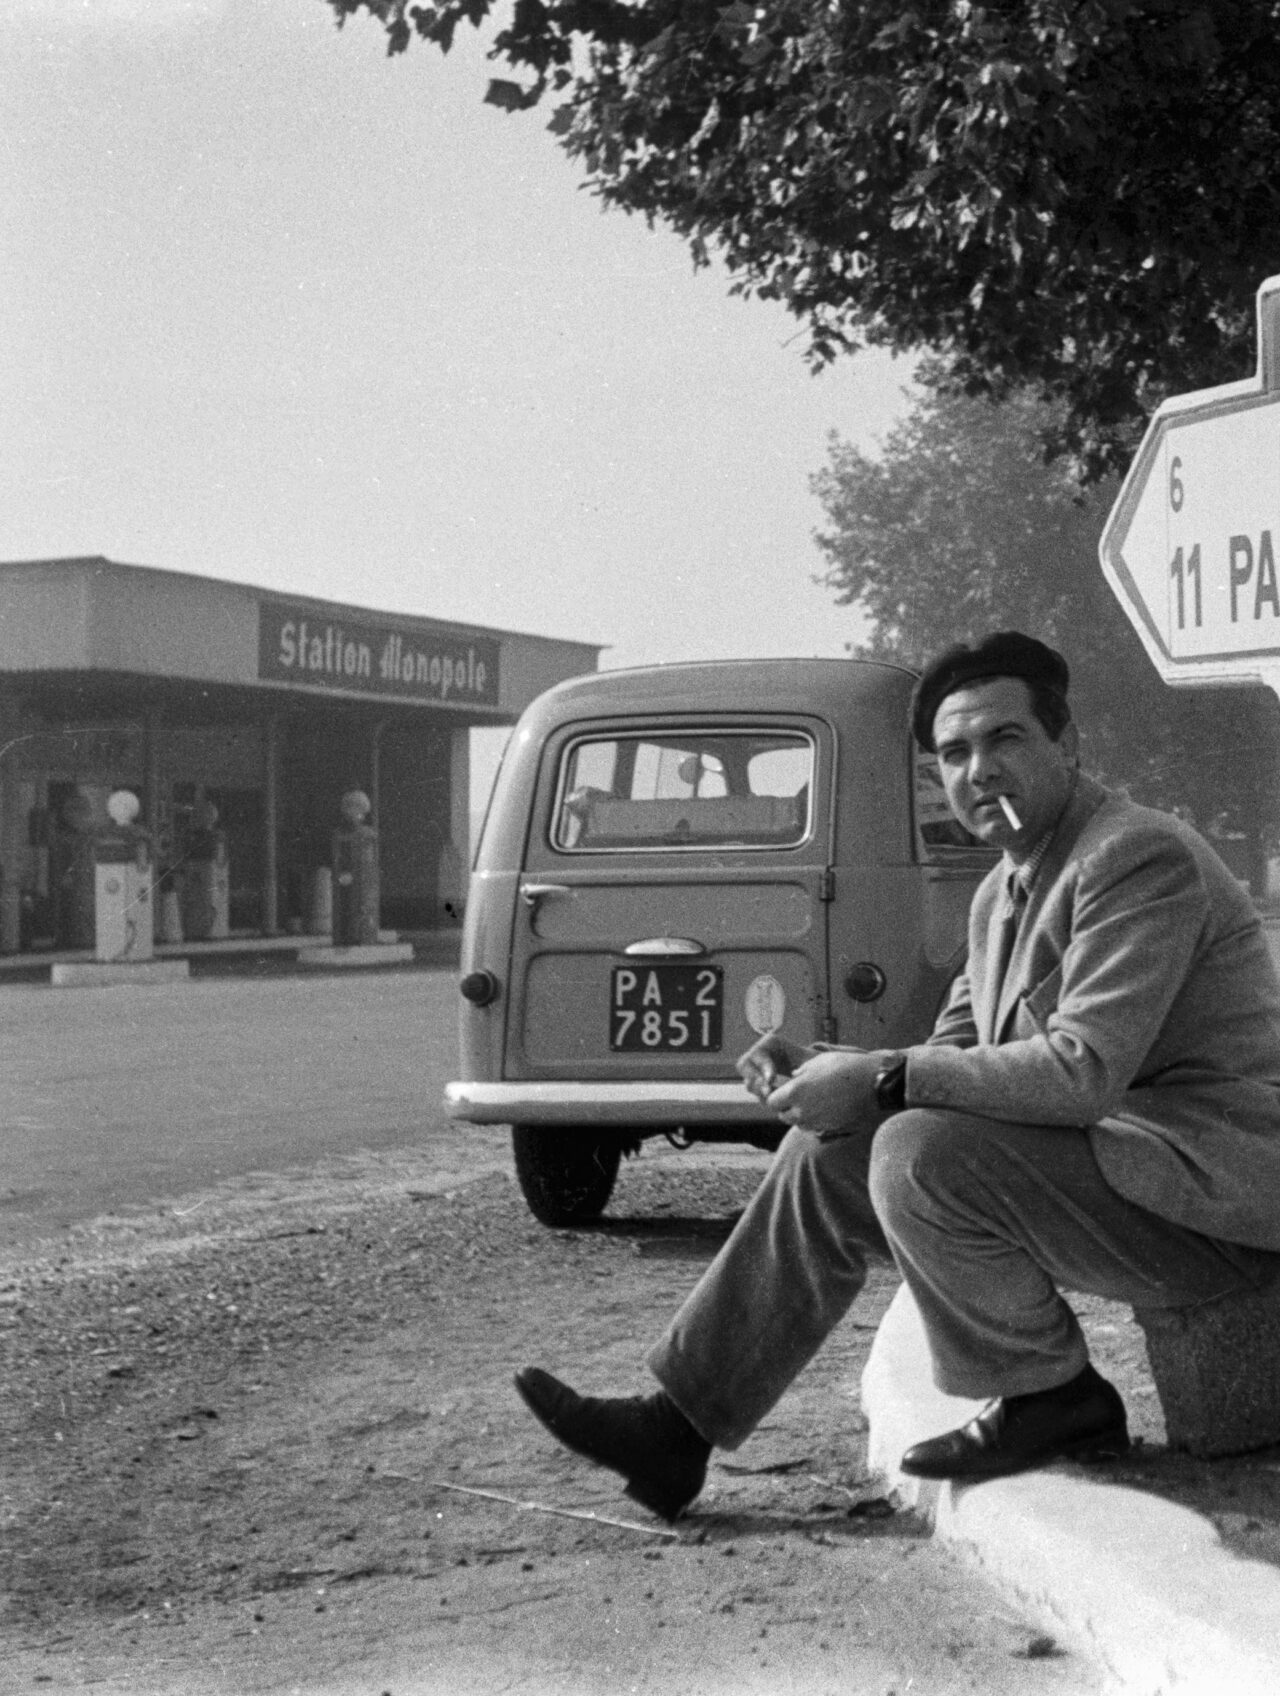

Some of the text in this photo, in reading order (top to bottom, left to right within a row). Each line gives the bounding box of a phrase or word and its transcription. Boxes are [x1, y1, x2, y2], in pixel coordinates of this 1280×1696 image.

[1169, 454, 1185, 513] 6
[1170, 542, 1203, 630] 11
[278, 620, 486, 699] Station Monopole
[615, 970, 717, 1007] PA 2
[615, 1009, 711, 1048] 7851
